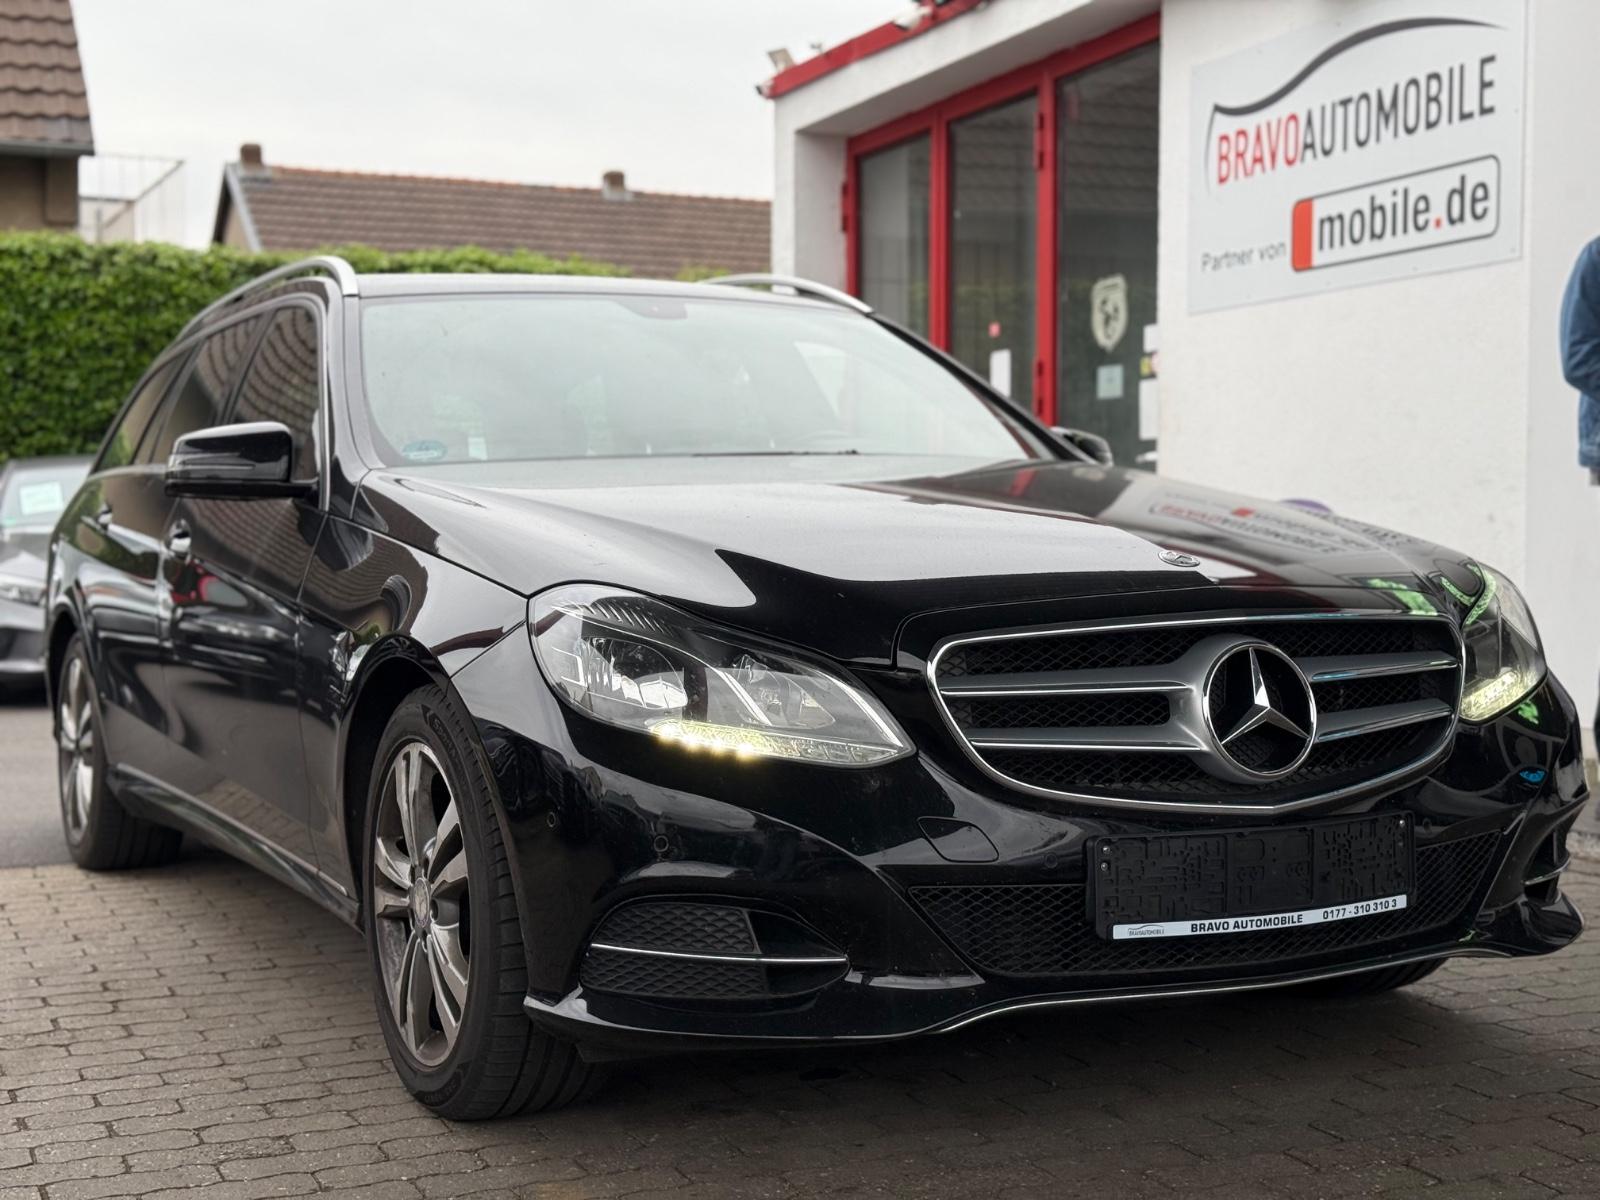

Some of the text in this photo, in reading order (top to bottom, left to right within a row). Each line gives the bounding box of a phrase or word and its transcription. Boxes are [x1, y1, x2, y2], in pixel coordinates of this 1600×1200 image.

[1201, 174, 1490, 272] Partner von mobile.de
[1190, 921, 1230, 933] BRAVO
[1232, 914, 1304, 930] AUTOMOBILE
[1322, 907, 1346, 920] 0177
[1353, 903, 1371, 915] 310
[1373, 901, 1390, 912] 310
[1391, 898, 1397, 908] 3
